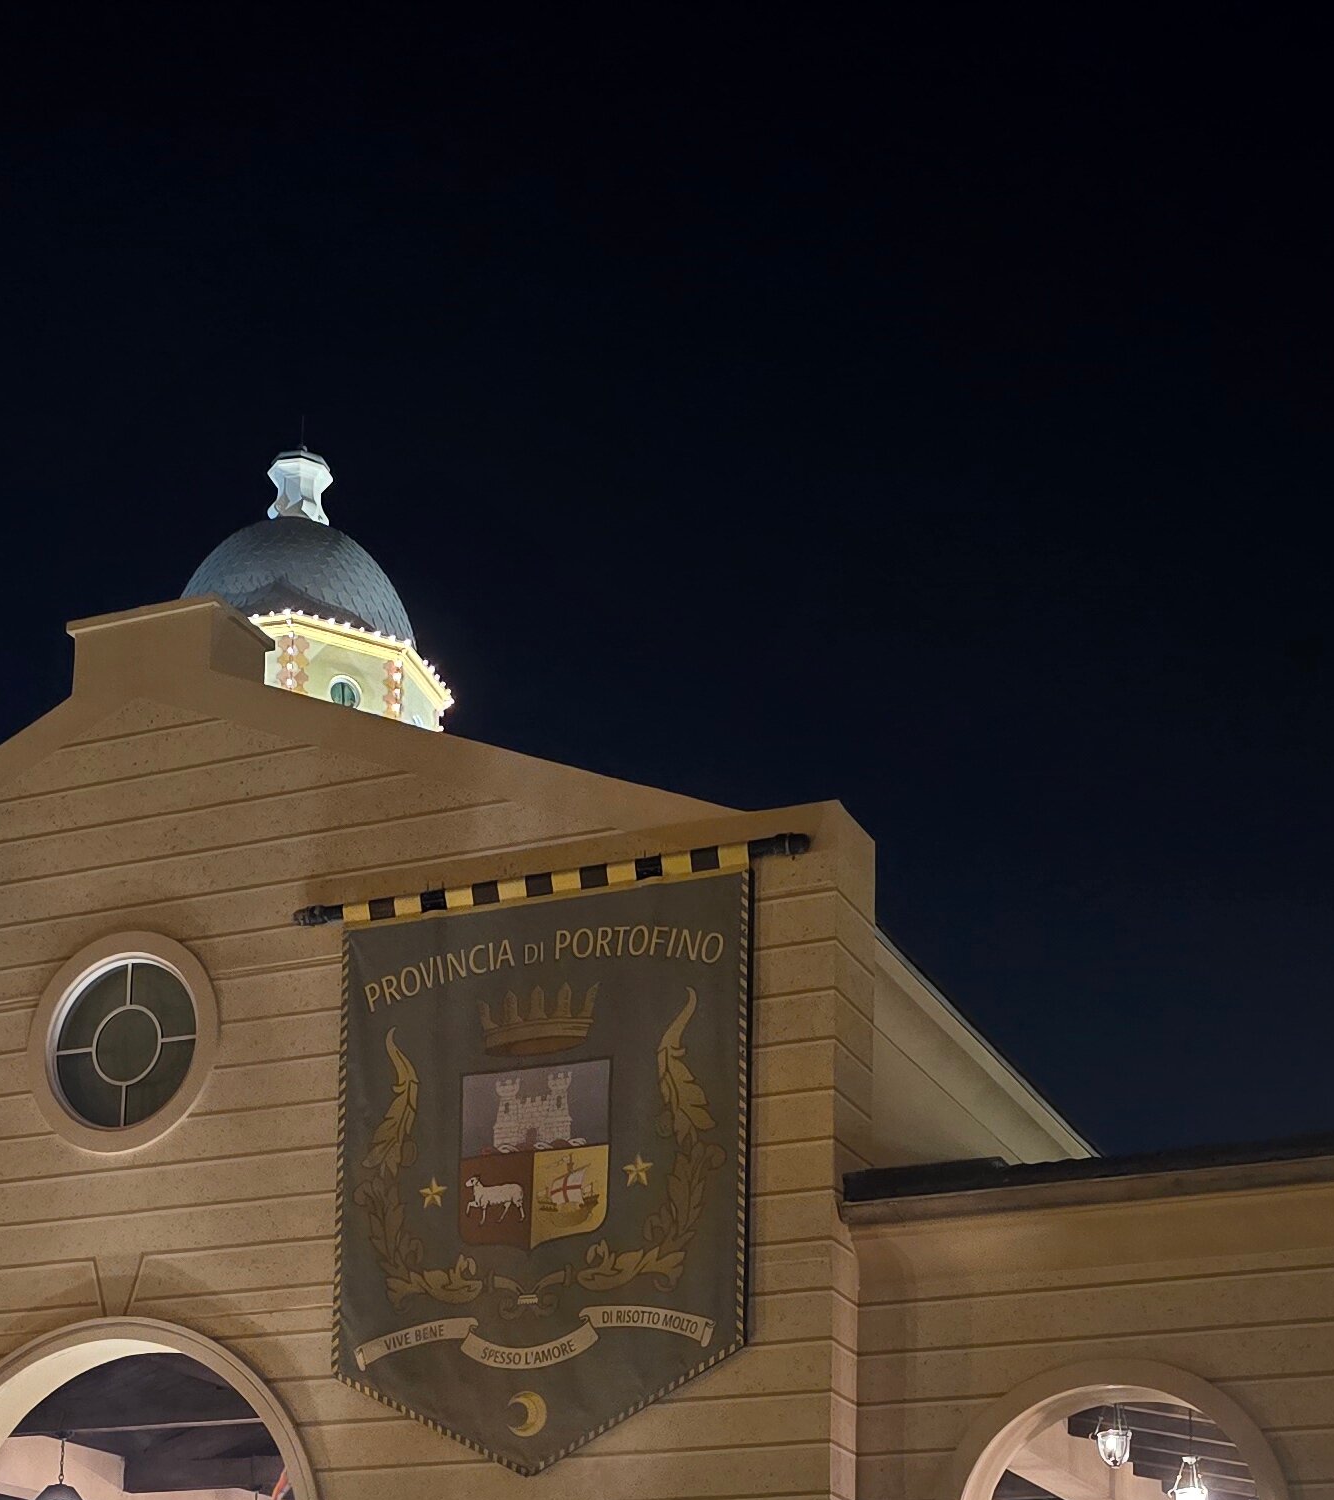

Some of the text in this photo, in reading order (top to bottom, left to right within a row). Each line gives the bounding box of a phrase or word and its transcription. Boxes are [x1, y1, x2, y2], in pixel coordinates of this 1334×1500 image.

[363, 924, 725, 1013] PROVINCIA DI PORTOFINO
[601, 1309, 699, 1335] DI RISOTTO MOLTO
[383, 1323, 445, 1352] VIVE BENE
[480, 1338, 577, 1366] SPESSO L'AMORE
